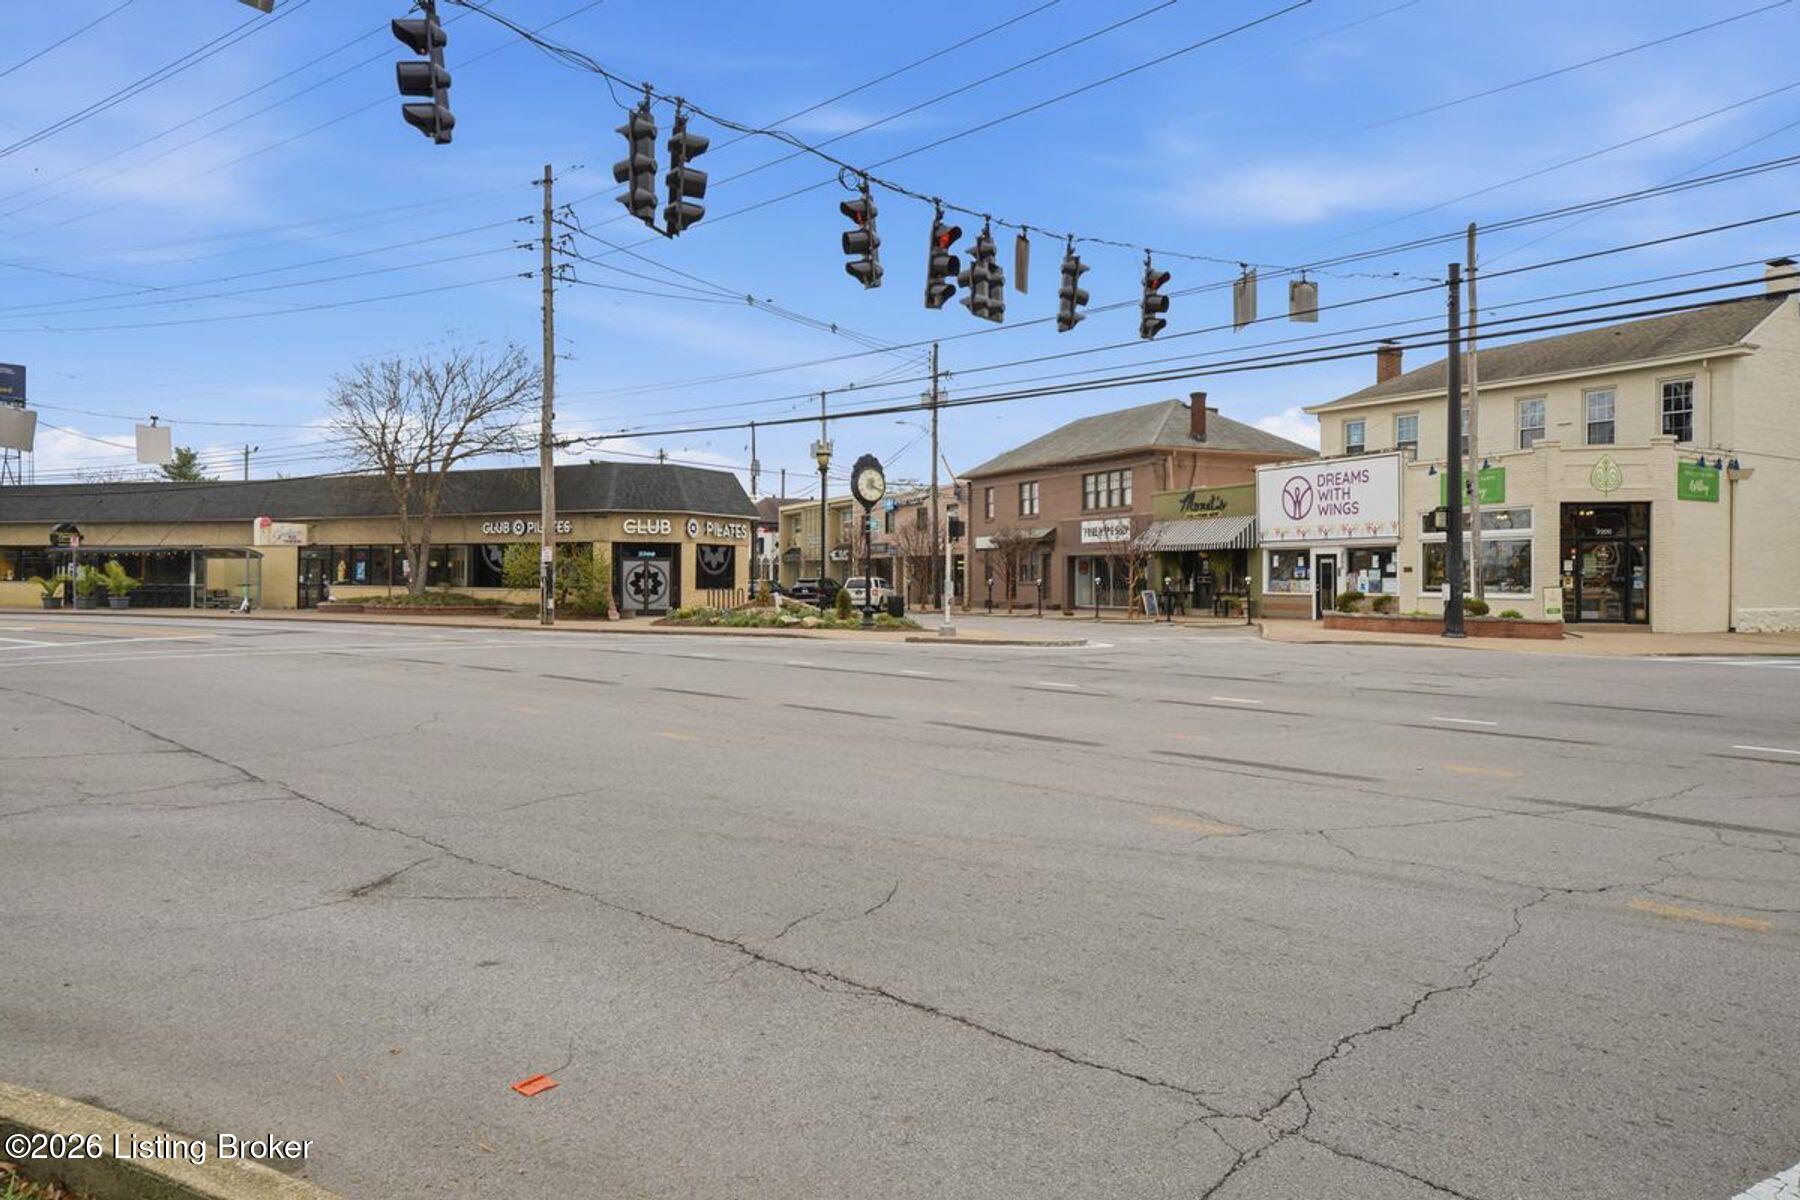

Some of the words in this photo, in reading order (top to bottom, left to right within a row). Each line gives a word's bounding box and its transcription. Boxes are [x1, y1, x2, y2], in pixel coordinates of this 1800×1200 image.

[1317, 469, 1370, 487] DREAMS
[1317, 487, 1351, 502] WITH
[1317, 501, 1360, 516] WINGS
[481, 521, 510, 534] CLUB
[526, 520, 571, 534] PILES
[622, 518, 672, 534] CLUB
[705, 521, 748, 539] PILATES
